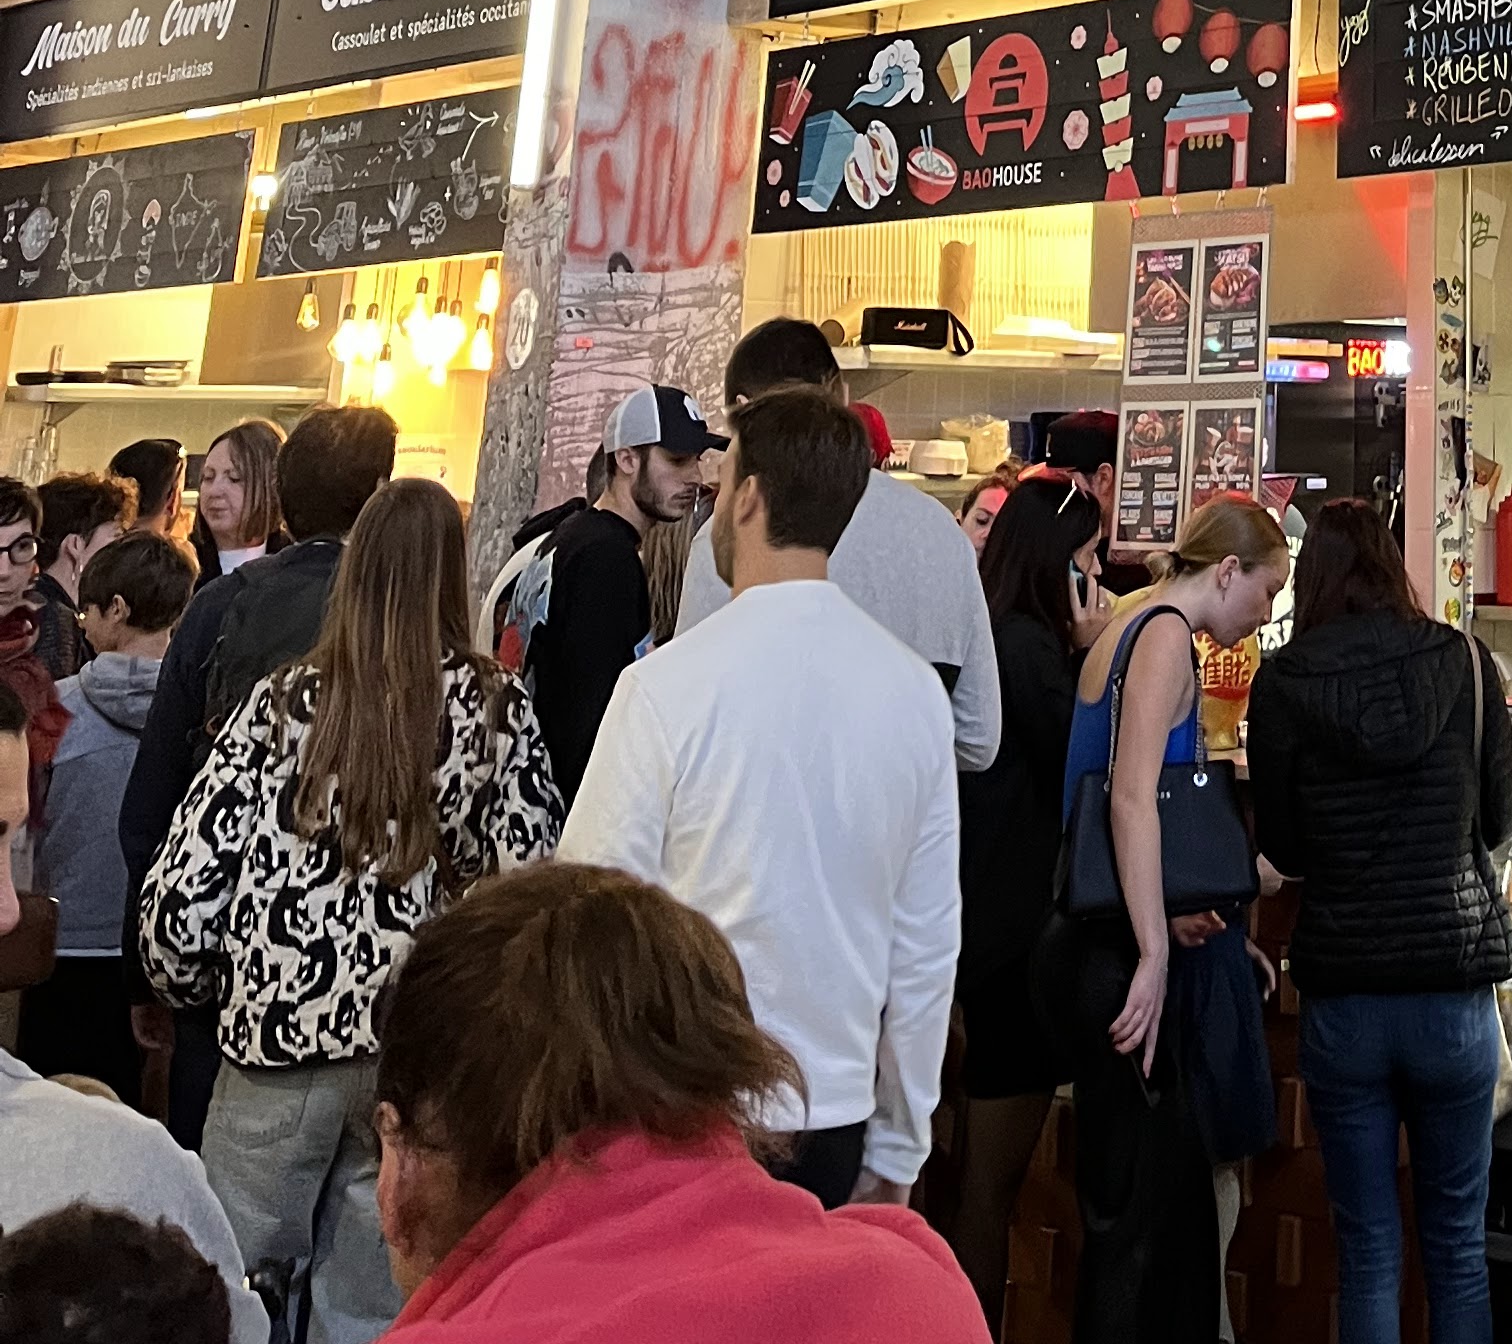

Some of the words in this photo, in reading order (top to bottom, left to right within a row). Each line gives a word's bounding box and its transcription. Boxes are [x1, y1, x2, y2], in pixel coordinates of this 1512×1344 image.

[20, 20, 113, 76] Maison
[117, 8, 150, 49] du
[331, 23, 386, 52] Cassoulet
[389, 19, 404, 41] et
[407, 4, 475, 41] spécialités
[25, 84, 79, 111] Spécialités
[81, 75, 129, 98] indiennes
[131, 70, 143, 90] et
[145, 59, 213, 87] sri-lankaises
[1421, 87, 1512, 126] GRILLED
[963, 162, 1042, 190] BAOHOUSE
